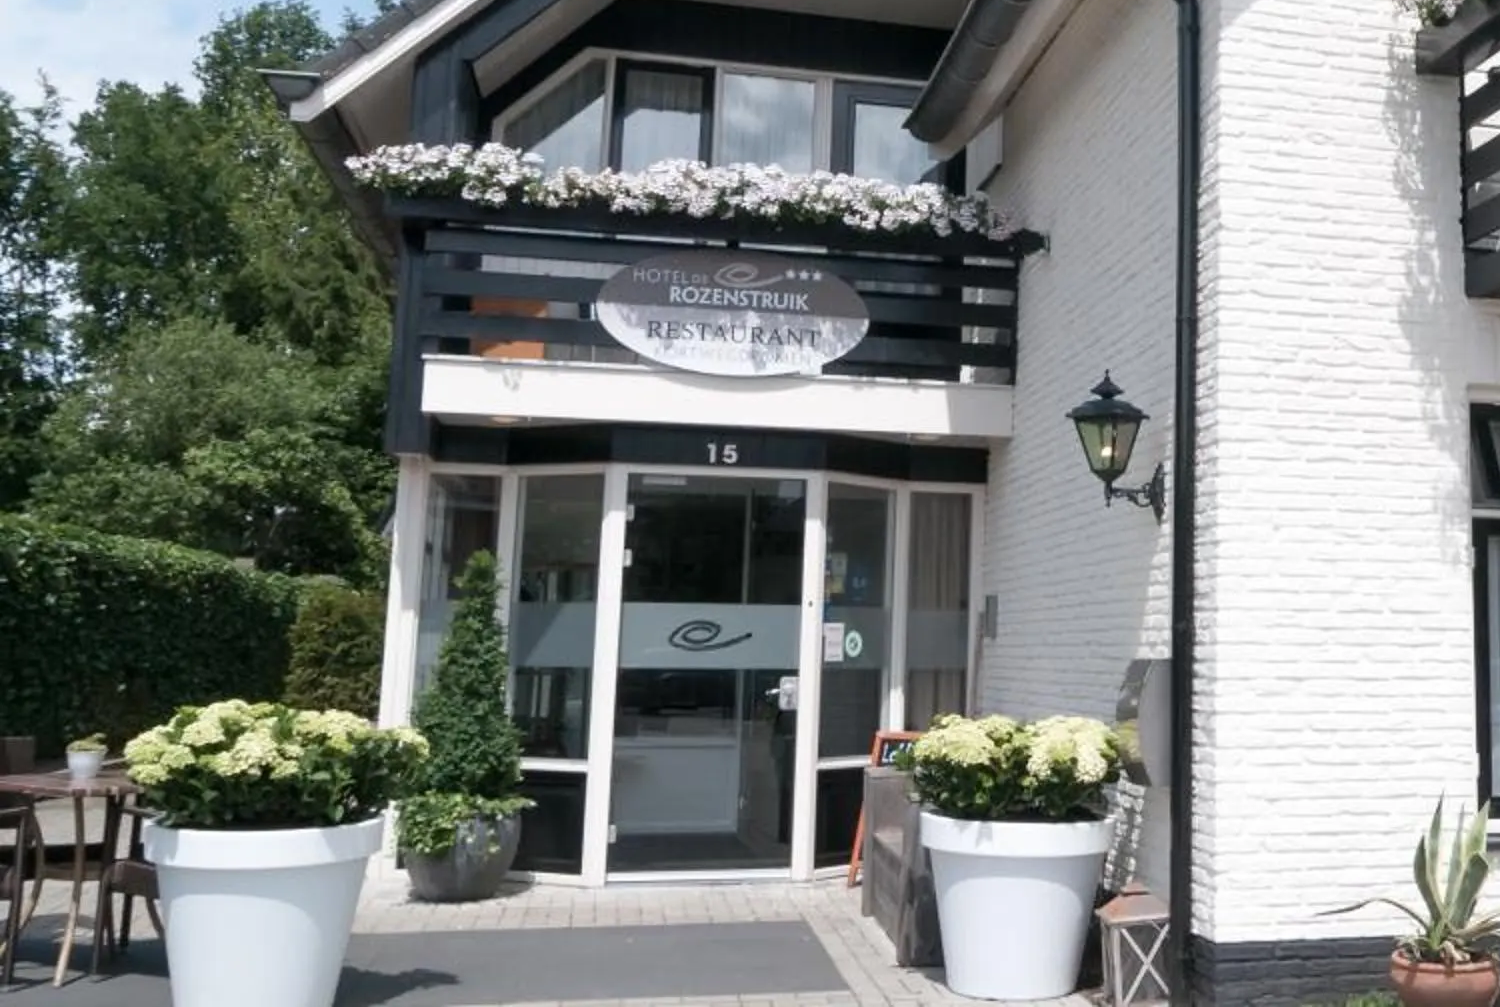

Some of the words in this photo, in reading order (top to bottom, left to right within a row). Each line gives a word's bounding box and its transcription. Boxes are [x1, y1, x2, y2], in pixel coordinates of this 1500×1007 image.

[633, 267, 689, 285] HOTEL
[669, 285, 809, 311] ROZENSTRUIK
[646, 320, 822, 347] RESTAURANT
[707, 443, 738, 464] 15
